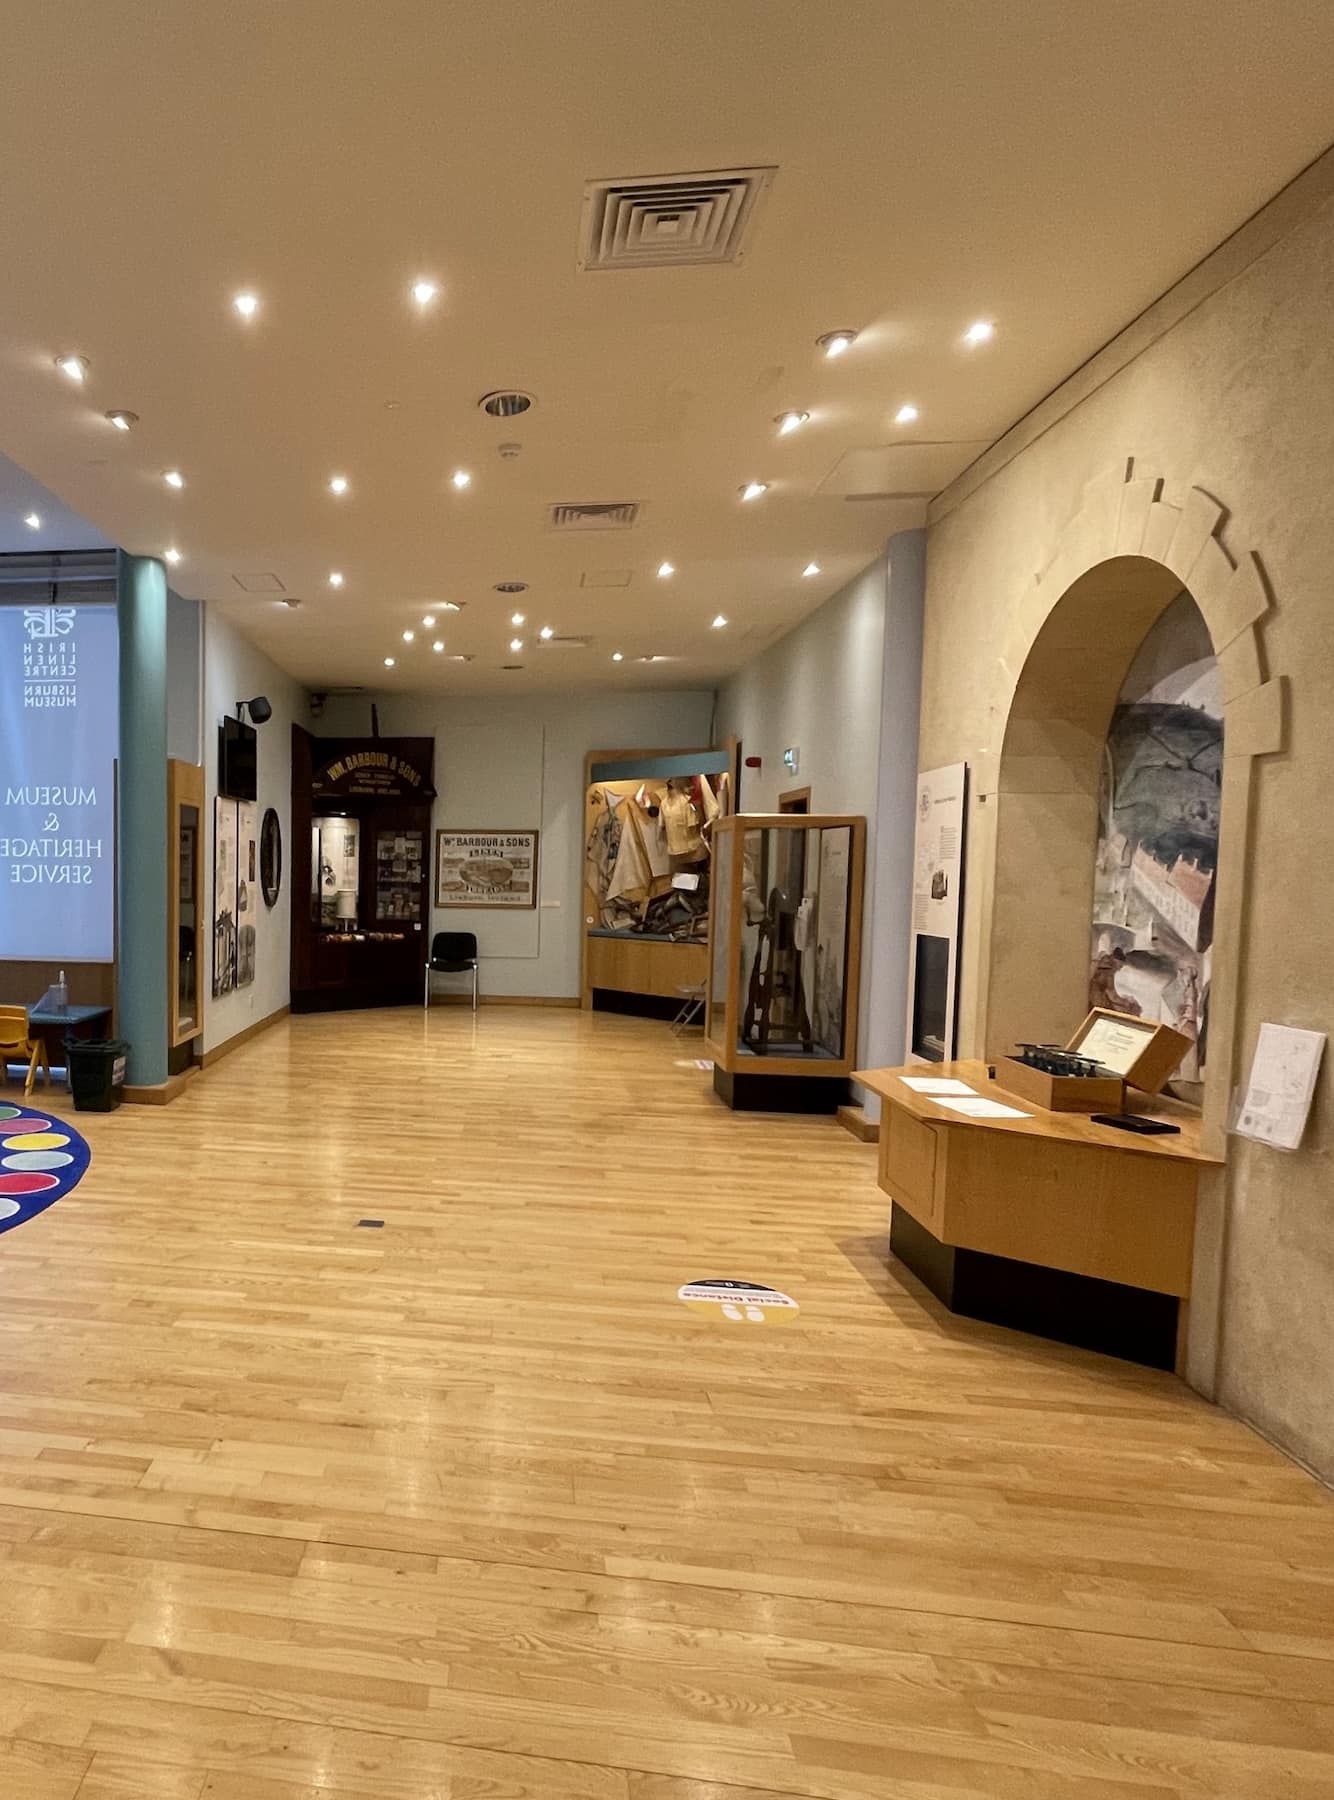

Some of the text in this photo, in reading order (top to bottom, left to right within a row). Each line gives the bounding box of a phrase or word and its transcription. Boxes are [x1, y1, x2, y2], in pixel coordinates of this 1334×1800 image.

[345, 751, 389, 770] BARBOUR
[398, 761, 421, 787] SONS
[456, 837, 498, 848] BARBOUR
[506, 837, 531, 848] SONS
[682, 1292, 743, 1302] Distance
[746, 1297, 789, 1305] Social
